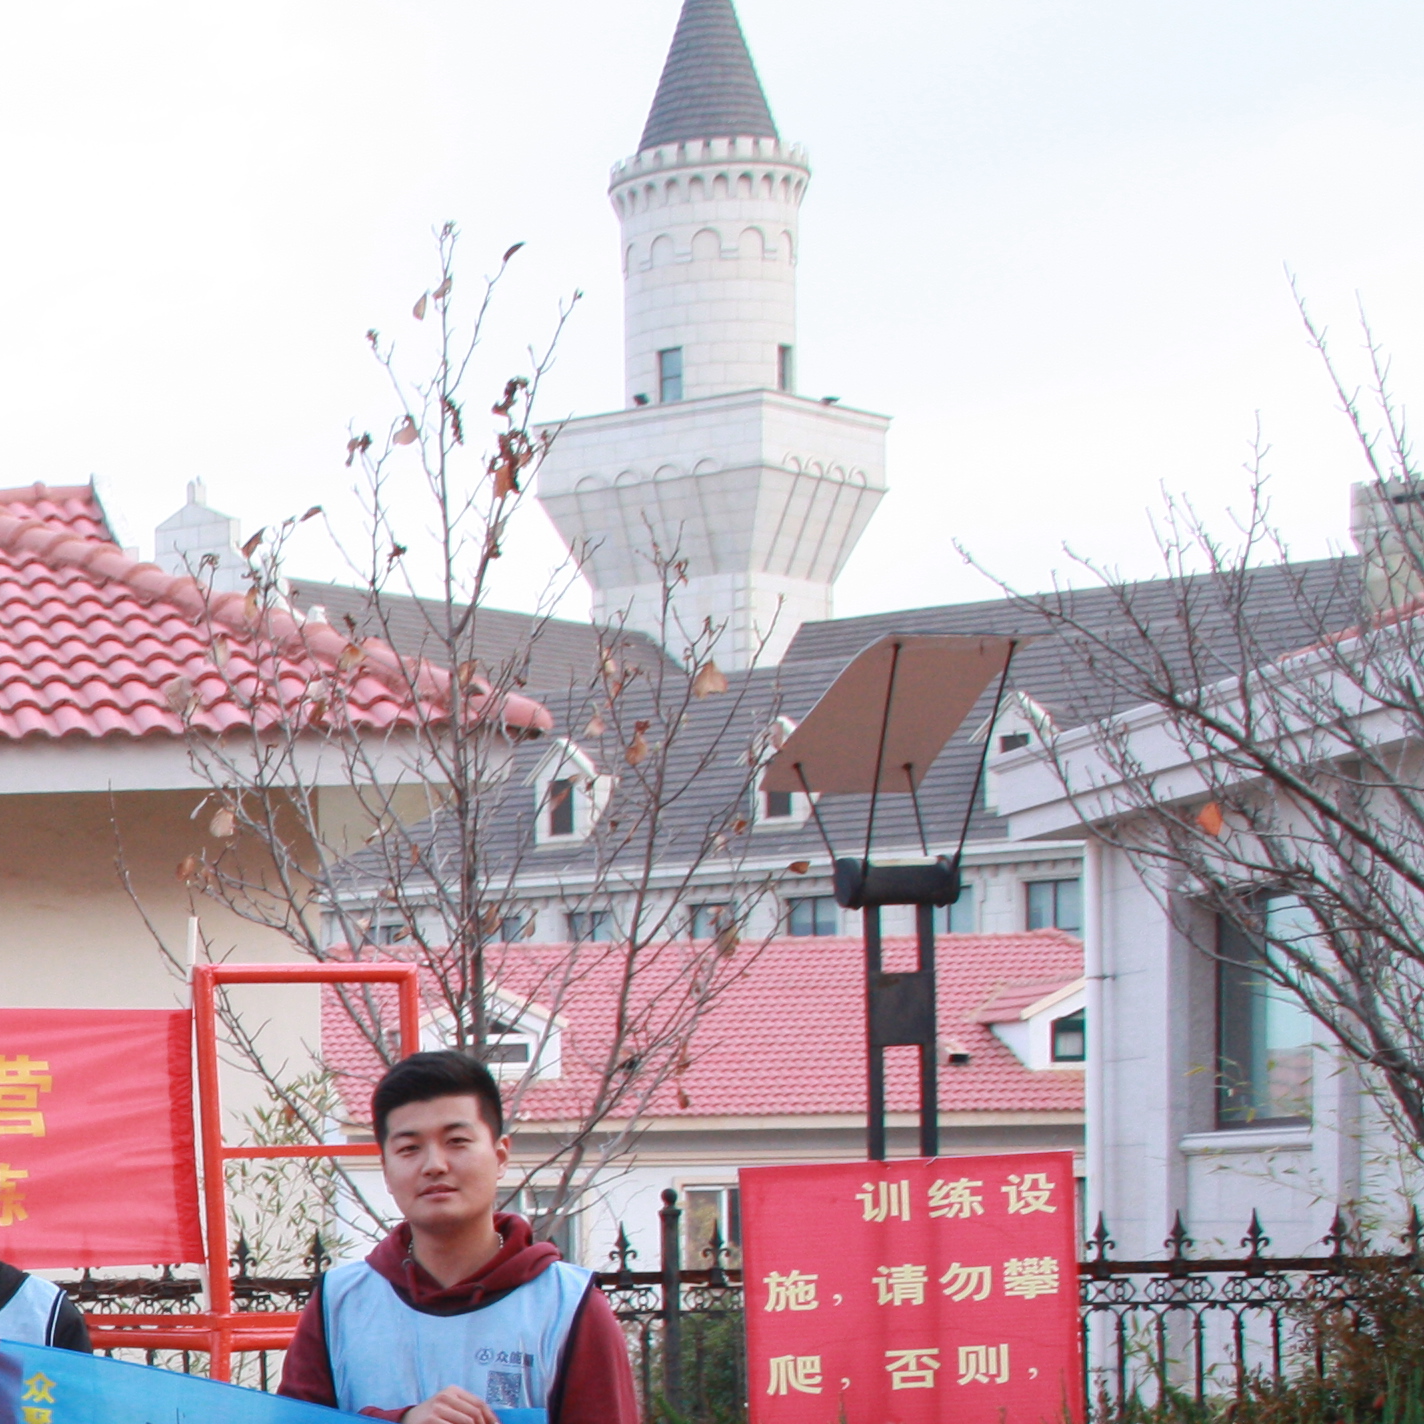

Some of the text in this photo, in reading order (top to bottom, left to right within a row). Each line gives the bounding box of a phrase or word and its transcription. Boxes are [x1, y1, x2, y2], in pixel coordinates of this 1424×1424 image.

[854, 1172, 1058, 1223] 训练设
[762, 1256, 1060, 1313] 施，请勿攀
[766, 1343, 1039, 1397] 爬，否则，
